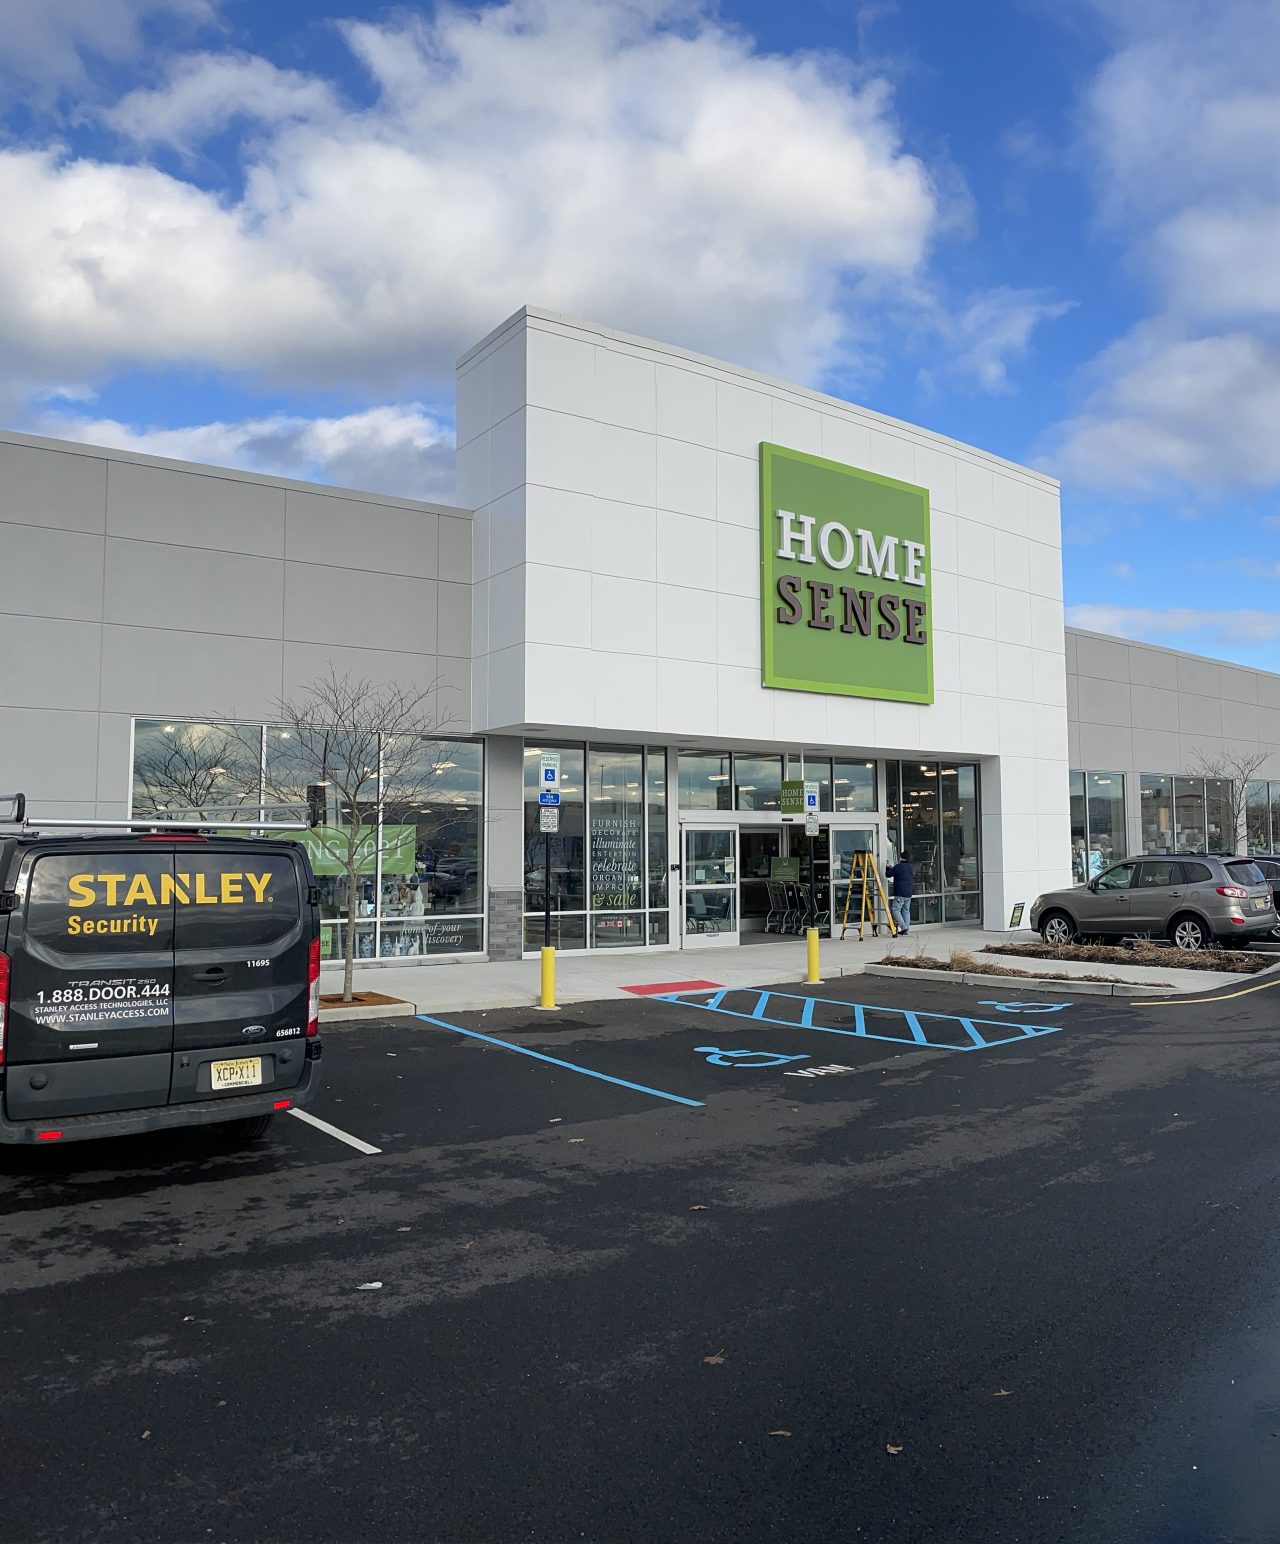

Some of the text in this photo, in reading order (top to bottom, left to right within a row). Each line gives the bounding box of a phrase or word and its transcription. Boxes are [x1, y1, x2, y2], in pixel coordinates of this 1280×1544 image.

[775, 509, 926, 587] HOME
[776, 575, 927, 645] SENSE
[782, 788, 804, 797] HOME
[781, 797, 804, 806] SENSE
[592, 819, 637, 828] FURNISH
[353, 838, 404, 860] 2021
[592, 837, 637, 849] illuminate
[592, 858, 637, 872] celebrate
[68, 873, 273, 908] STANLEY
[592, 882, 637, 891] IMPROVE
[593, 893, 637, 907] & save
[67, 913, 159, 936] Security
[401, 922, 462, 936] home of your
[246, 959, 270, 968] 11695
[68, 978, 136, 987] TRANSIT
[36, 983, 171, 1004] 1.888.DOOR.444
[35, 998, 169, 1014] STANLEY ACCESS TECHNOLOGIES, LLC
[35, 1007, 169, 1025] WWW.STANLEYACCESS.COM
[276, 1027, 301, 1037] 656812
